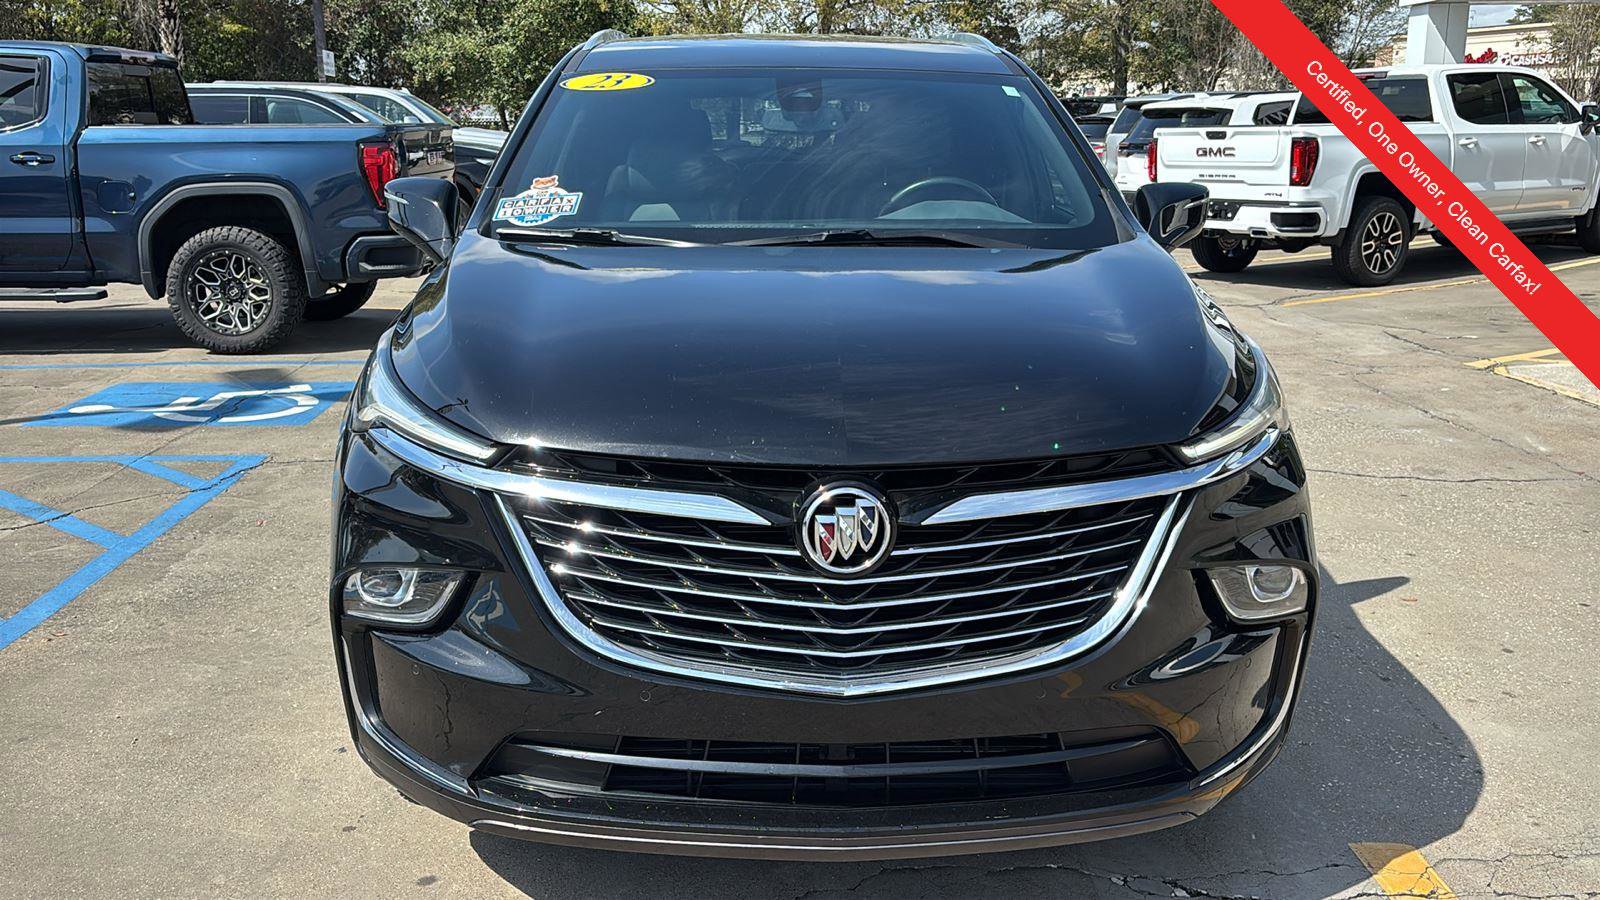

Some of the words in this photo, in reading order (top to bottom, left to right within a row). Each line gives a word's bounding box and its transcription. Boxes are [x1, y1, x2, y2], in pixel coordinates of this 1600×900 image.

[581, 75, 632, 89] 23
[1196, 147, 1236, 157] GMC
[503, 198, 573, 208] CARFAX
